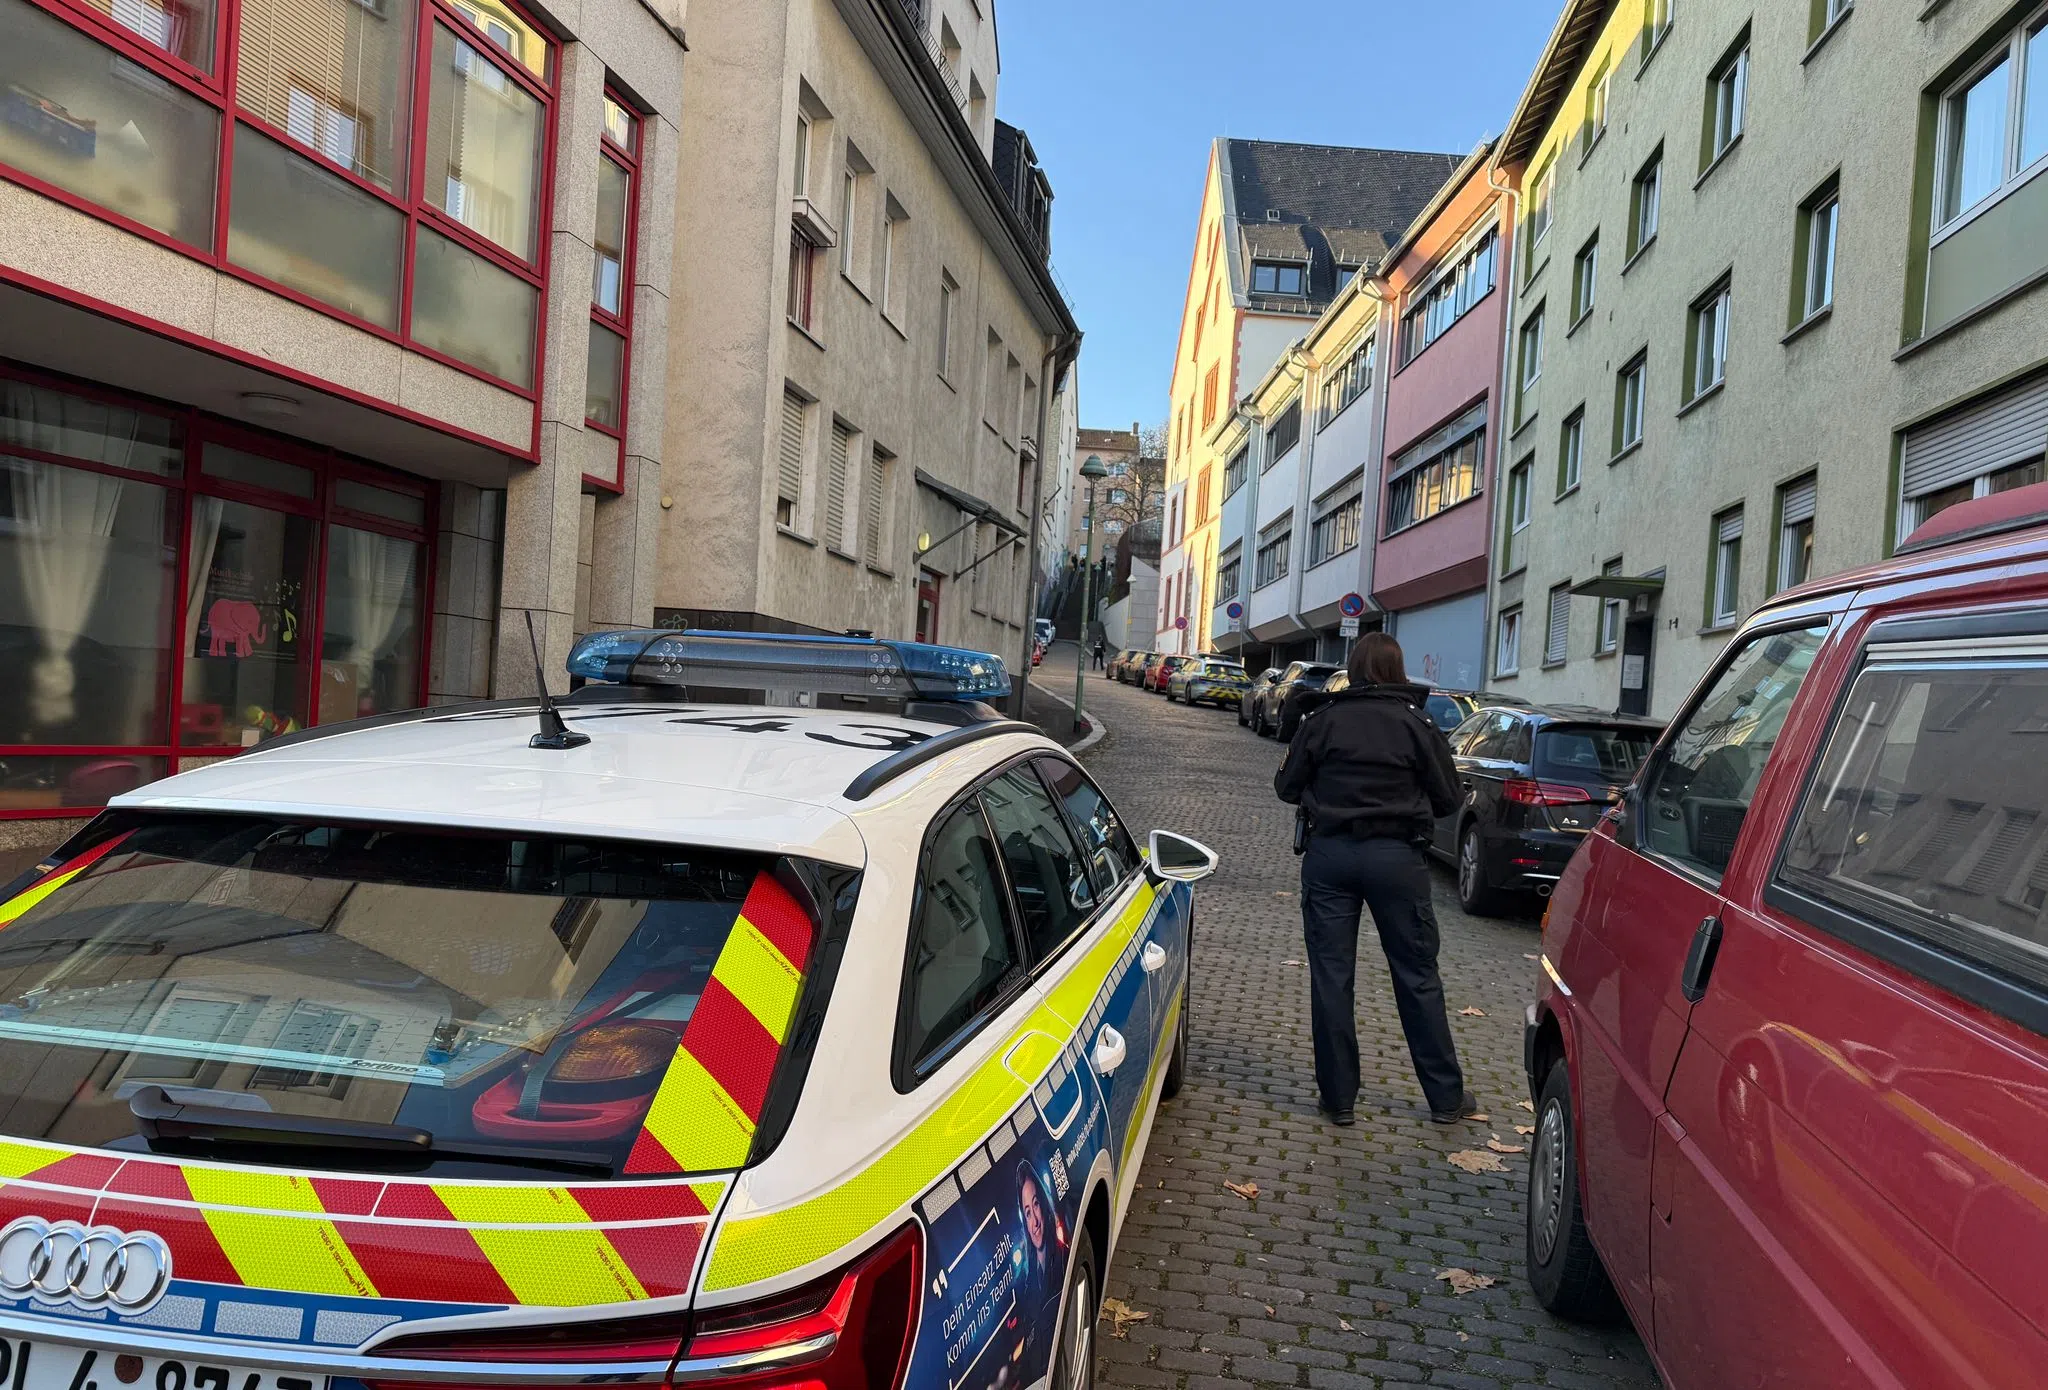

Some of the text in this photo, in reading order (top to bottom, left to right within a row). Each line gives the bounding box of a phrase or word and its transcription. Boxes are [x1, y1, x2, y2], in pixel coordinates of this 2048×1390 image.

[943, 1233, 1013, 1340] Dein Einsatz zählt.
[946, 1263, 1012, 1368] Komm ins Team!
